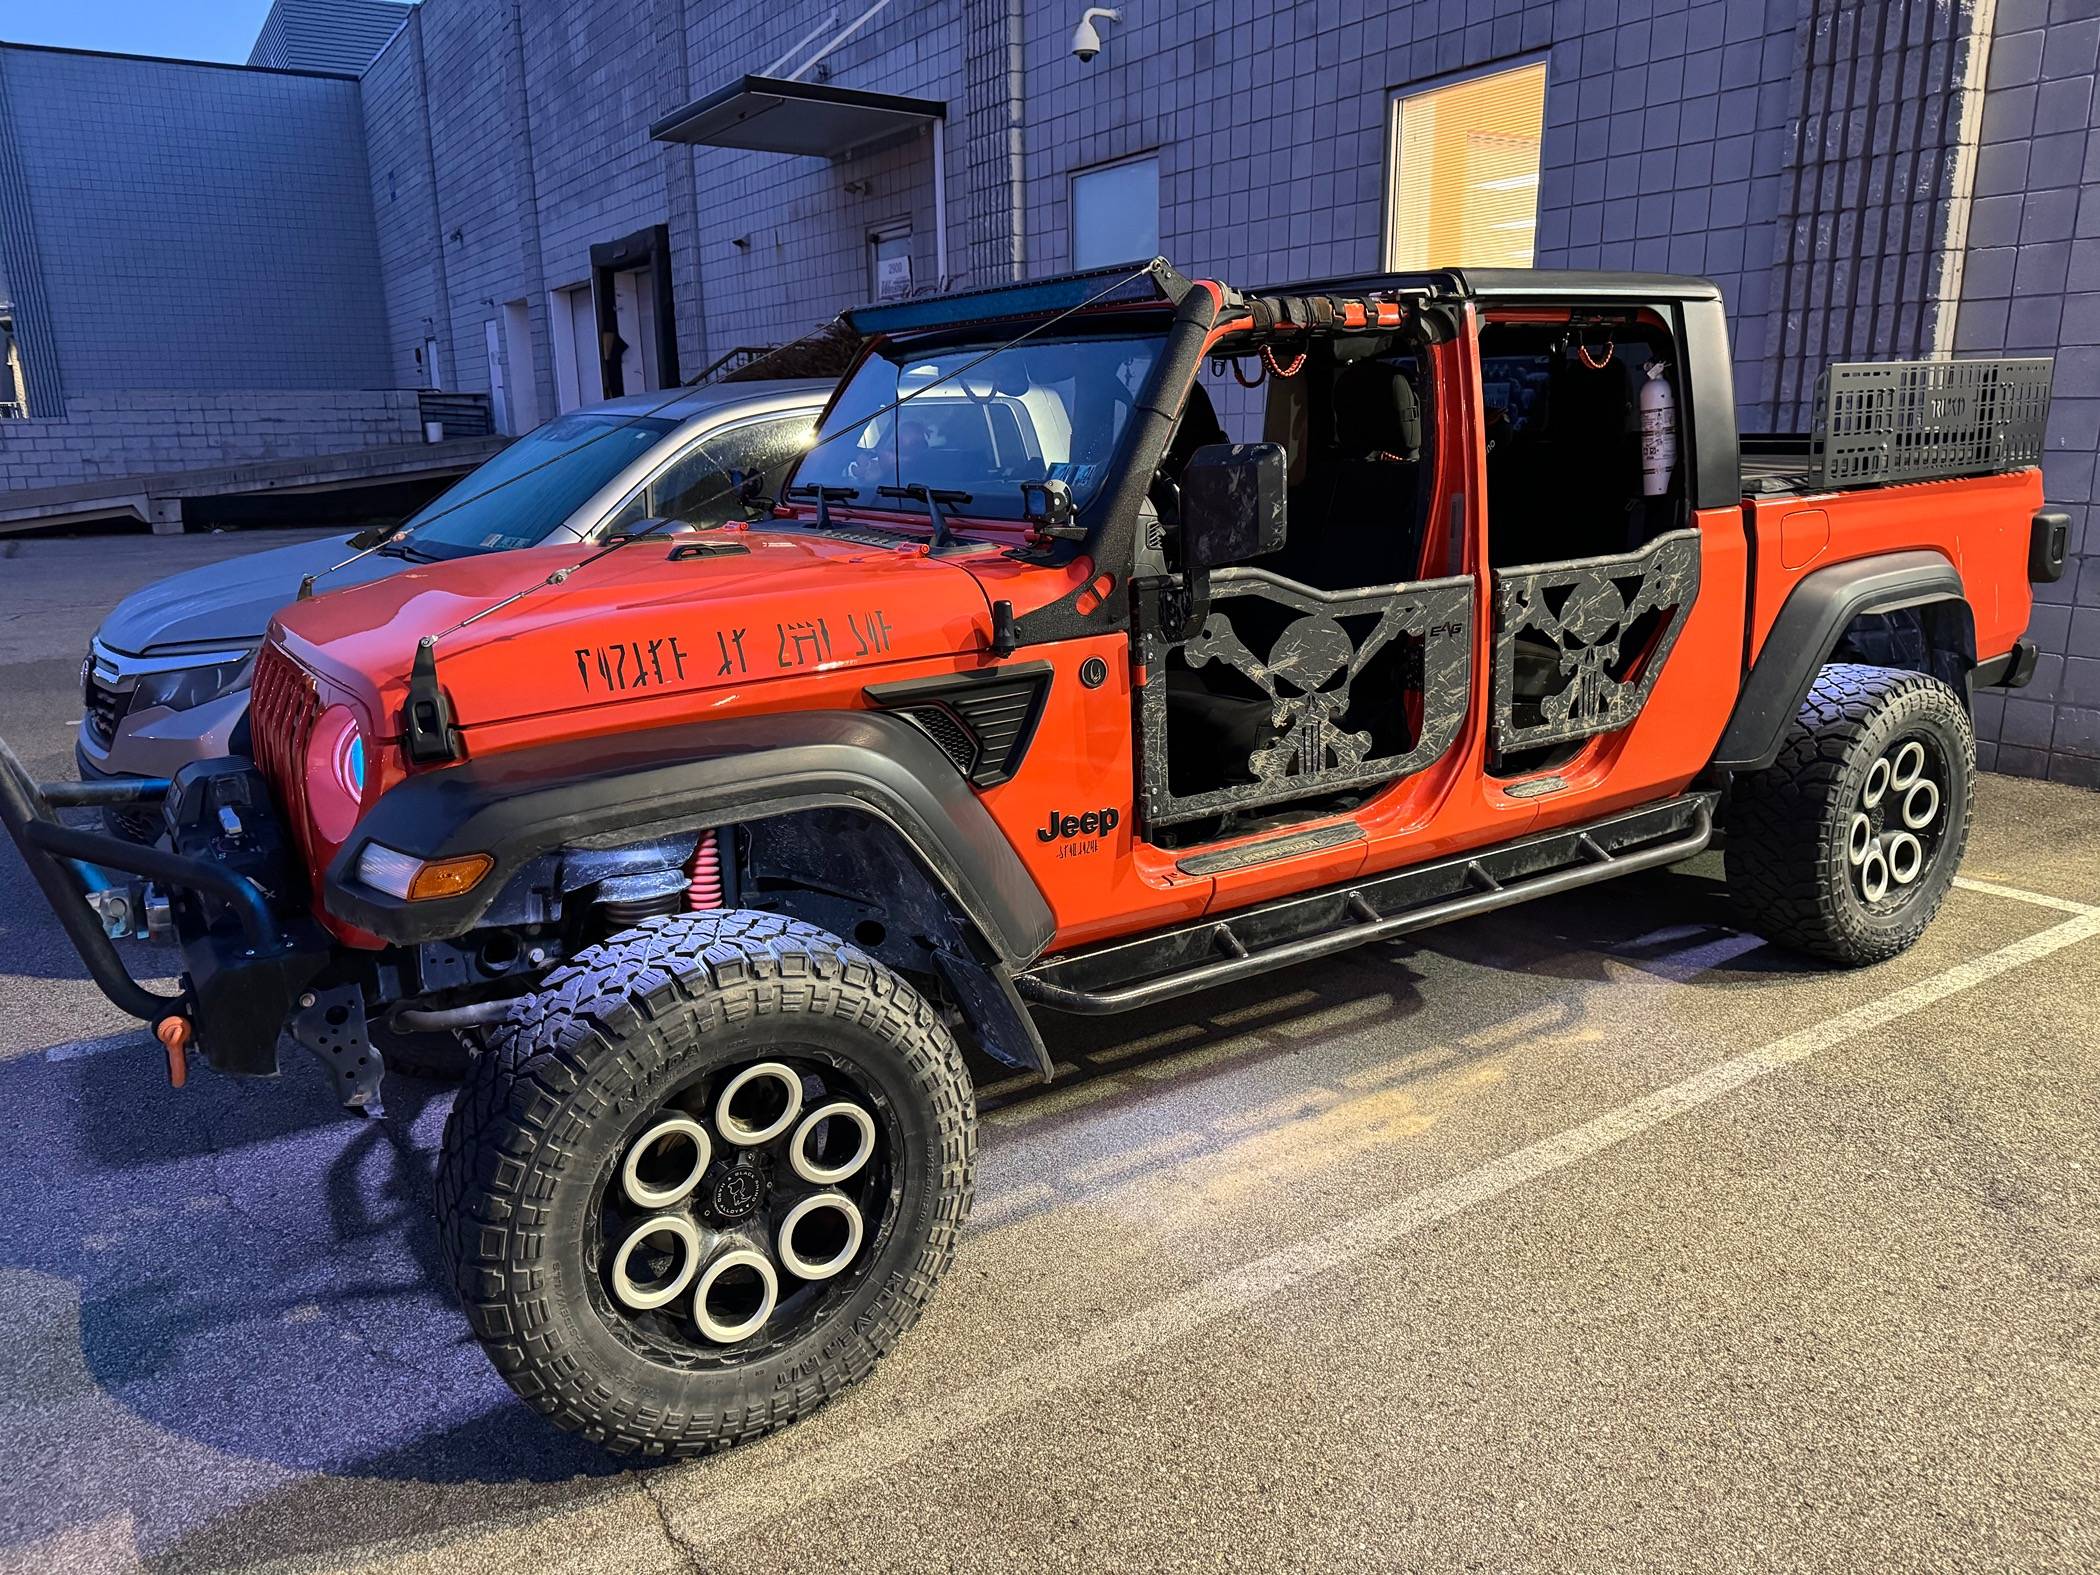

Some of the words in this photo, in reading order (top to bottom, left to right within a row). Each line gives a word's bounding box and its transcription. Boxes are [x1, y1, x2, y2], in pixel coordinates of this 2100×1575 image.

[1037, 807, 1119, 842] Jeep
[615, 1041, 701, 1115] KENDA
[751, 1180, 760, 1202] RHINO
[822, 1270, 905, 1360] KLEVER
[774, 1353, 823, 1391] R/T
